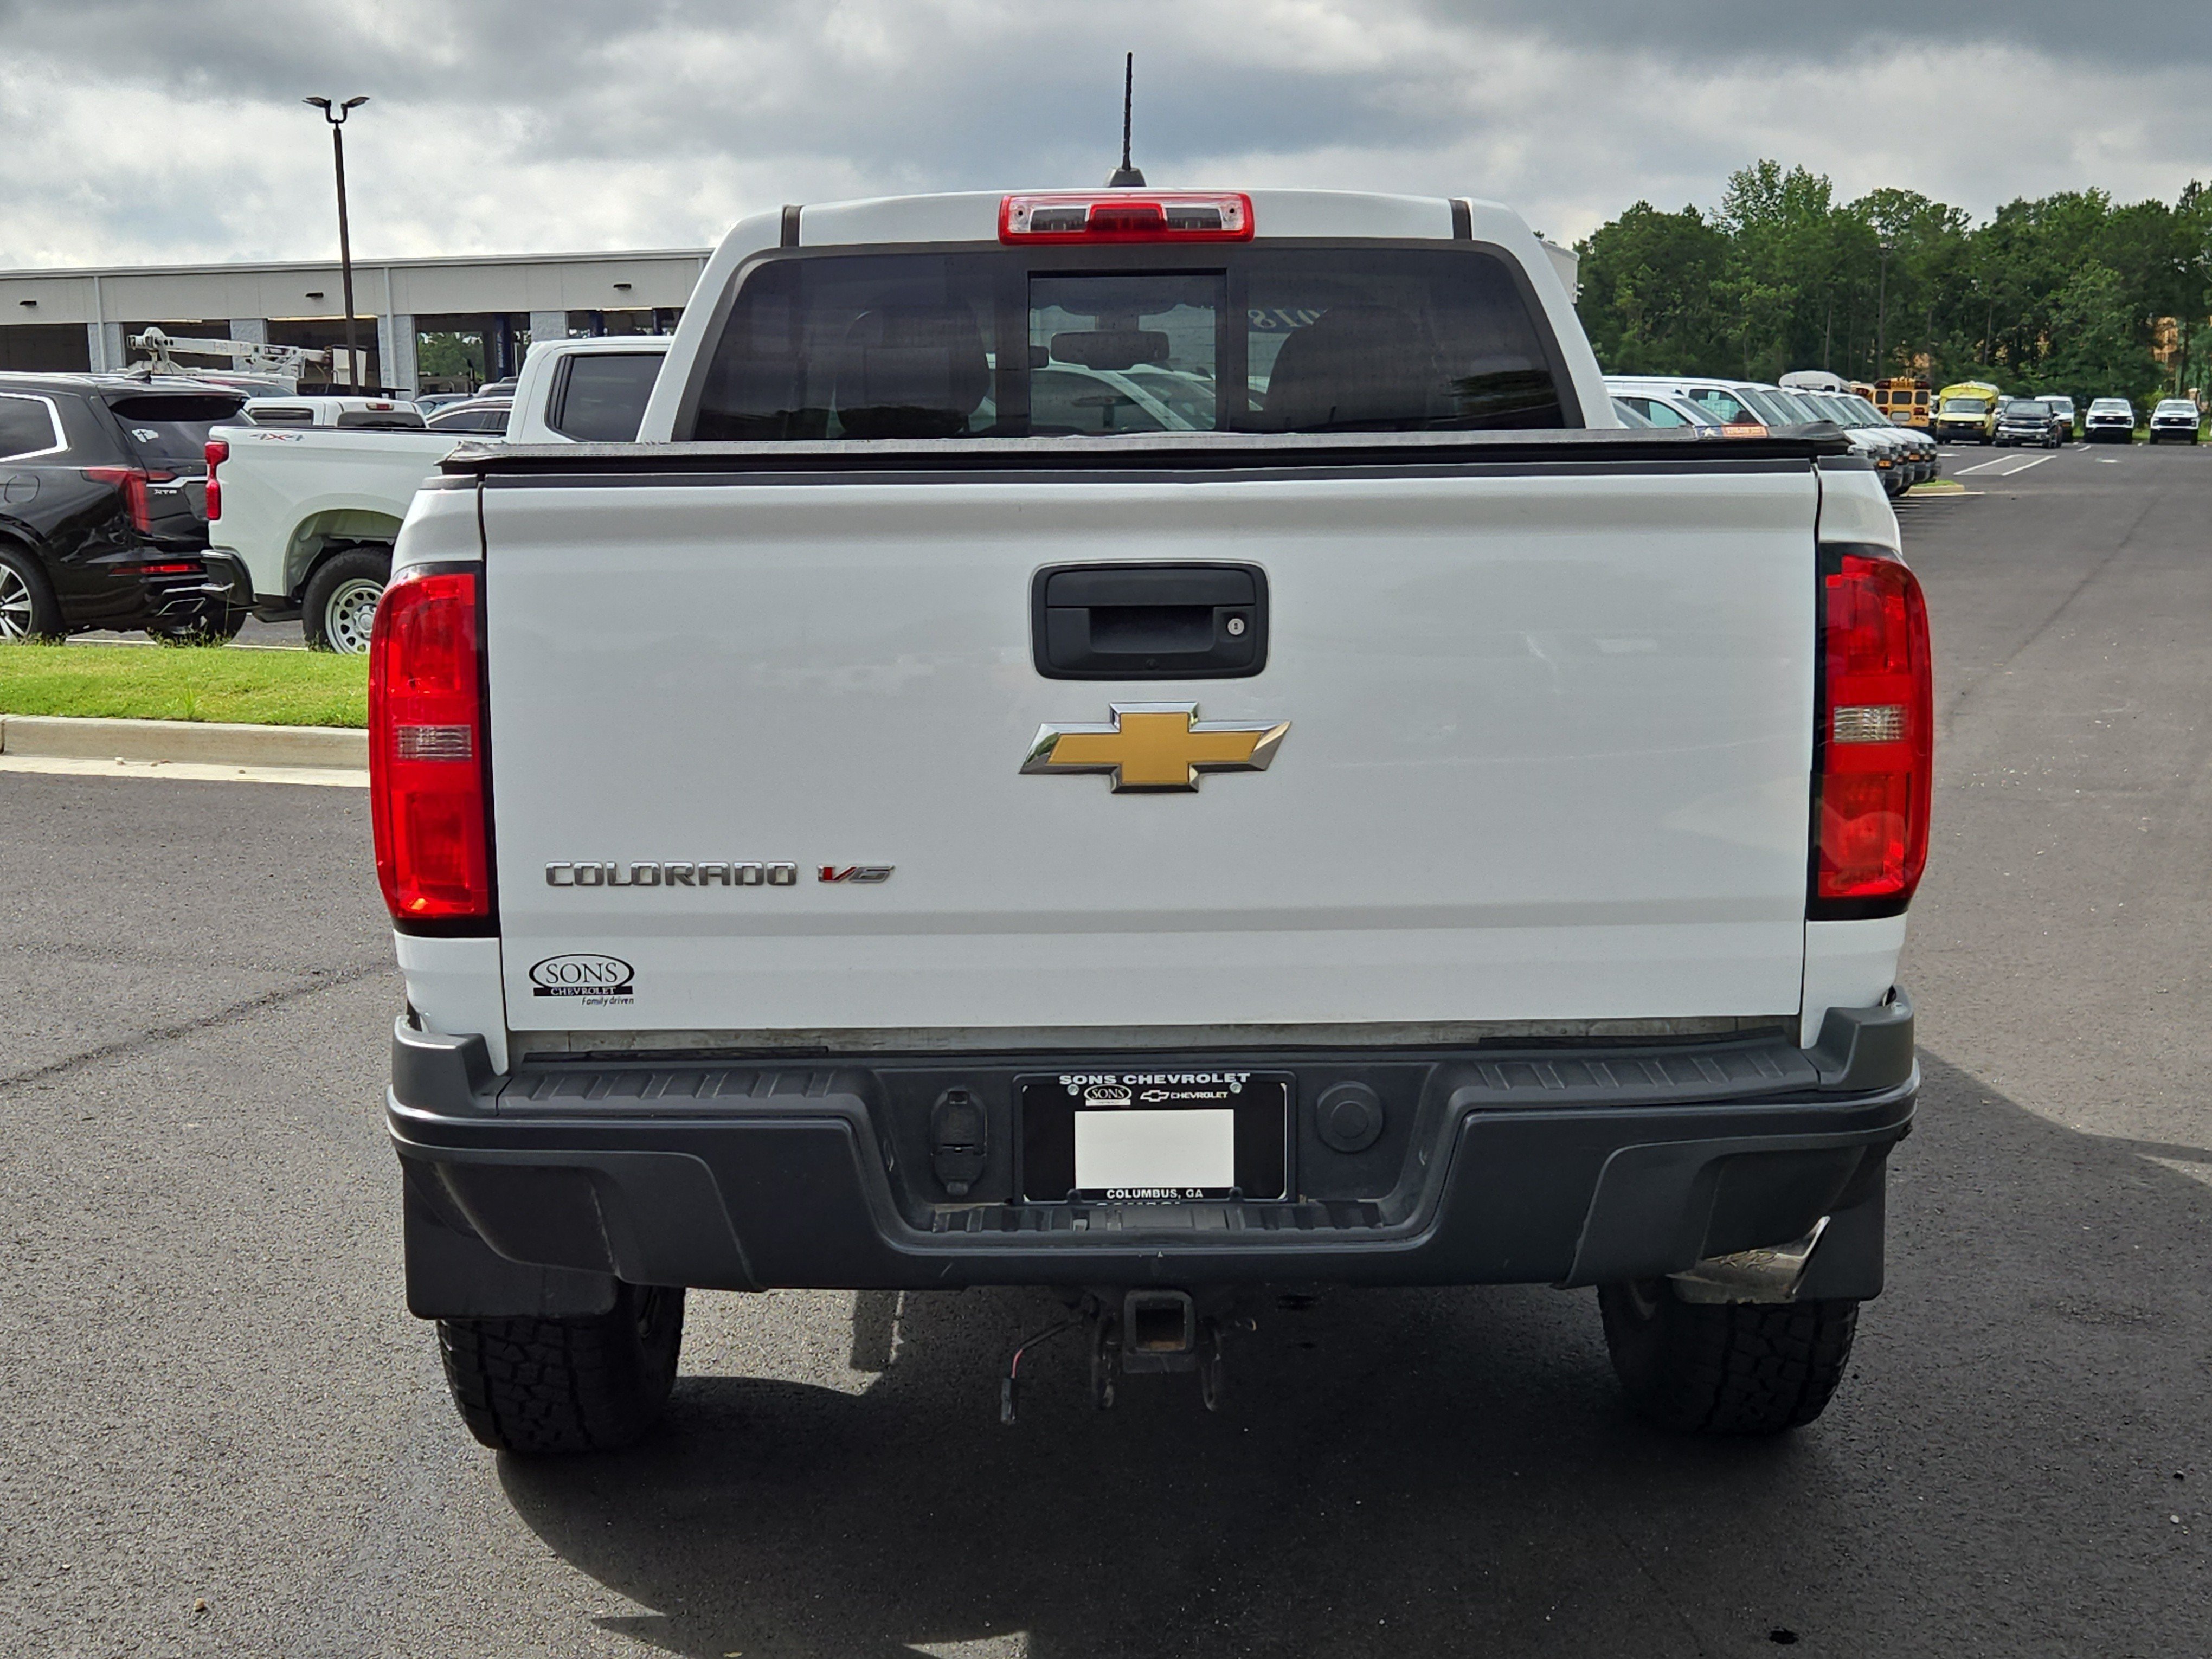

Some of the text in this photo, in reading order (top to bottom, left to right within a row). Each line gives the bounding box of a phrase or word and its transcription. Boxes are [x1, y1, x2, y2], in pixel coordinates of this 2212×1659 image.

[545, 861, 895, 887] COLORADO V6
[546, 962, 618, 984] SONS
[550, 987, 616, 996] CHEVROLET
[1059, 1073, 1250, 1085] SONS CHEVROLET
[1091, 1088, 1125, 1100] SONS
[1171, 1091, 1229, 1099] CHEVROLET
[1106, 1188, 1204, 1200] COLUMBUS, GA
